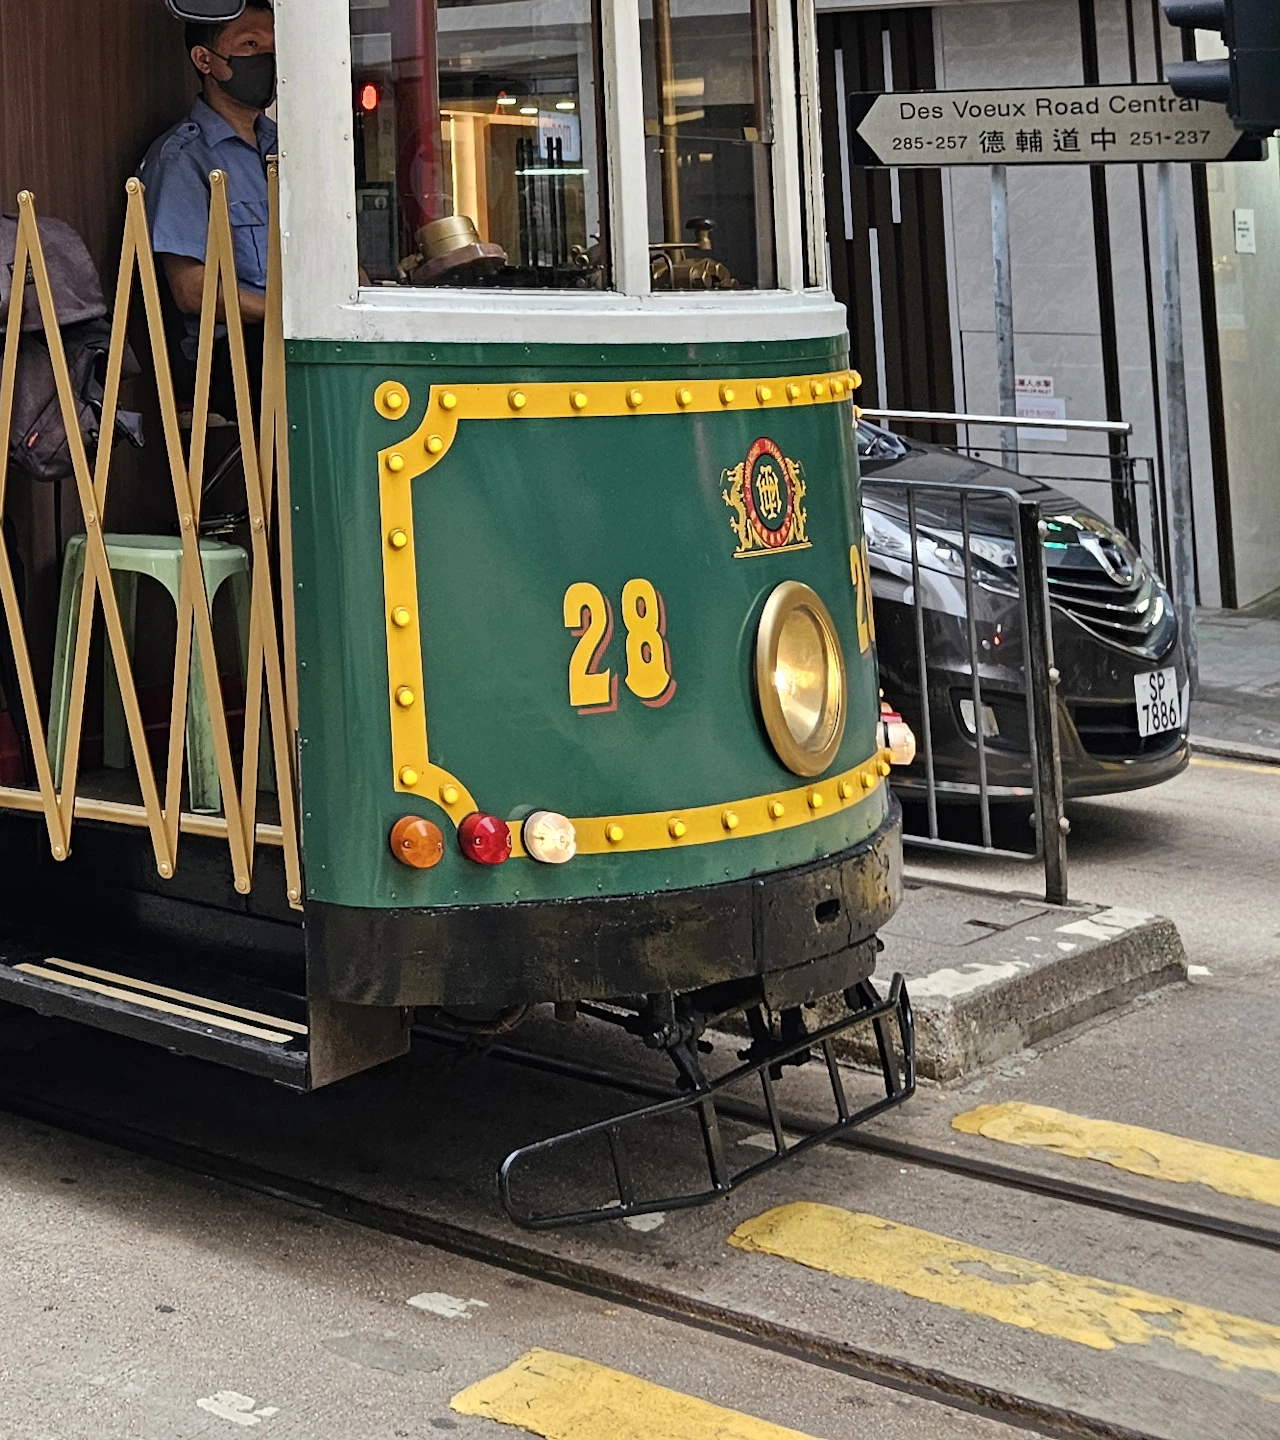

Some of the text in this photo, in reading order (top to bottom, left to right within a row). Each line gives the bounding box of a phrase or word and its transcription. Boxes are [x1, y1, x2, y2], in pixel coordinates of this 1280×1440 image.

[900, 94, 1200, 121] Des Voeux Road Central
[892, 127, 1211, 155] 285-257 德輔道中 251-237
[563, 577, 676, 714] 28
[1149, 671, 1165, 702] SP
[1142, 698, 1177, 734] 7886
